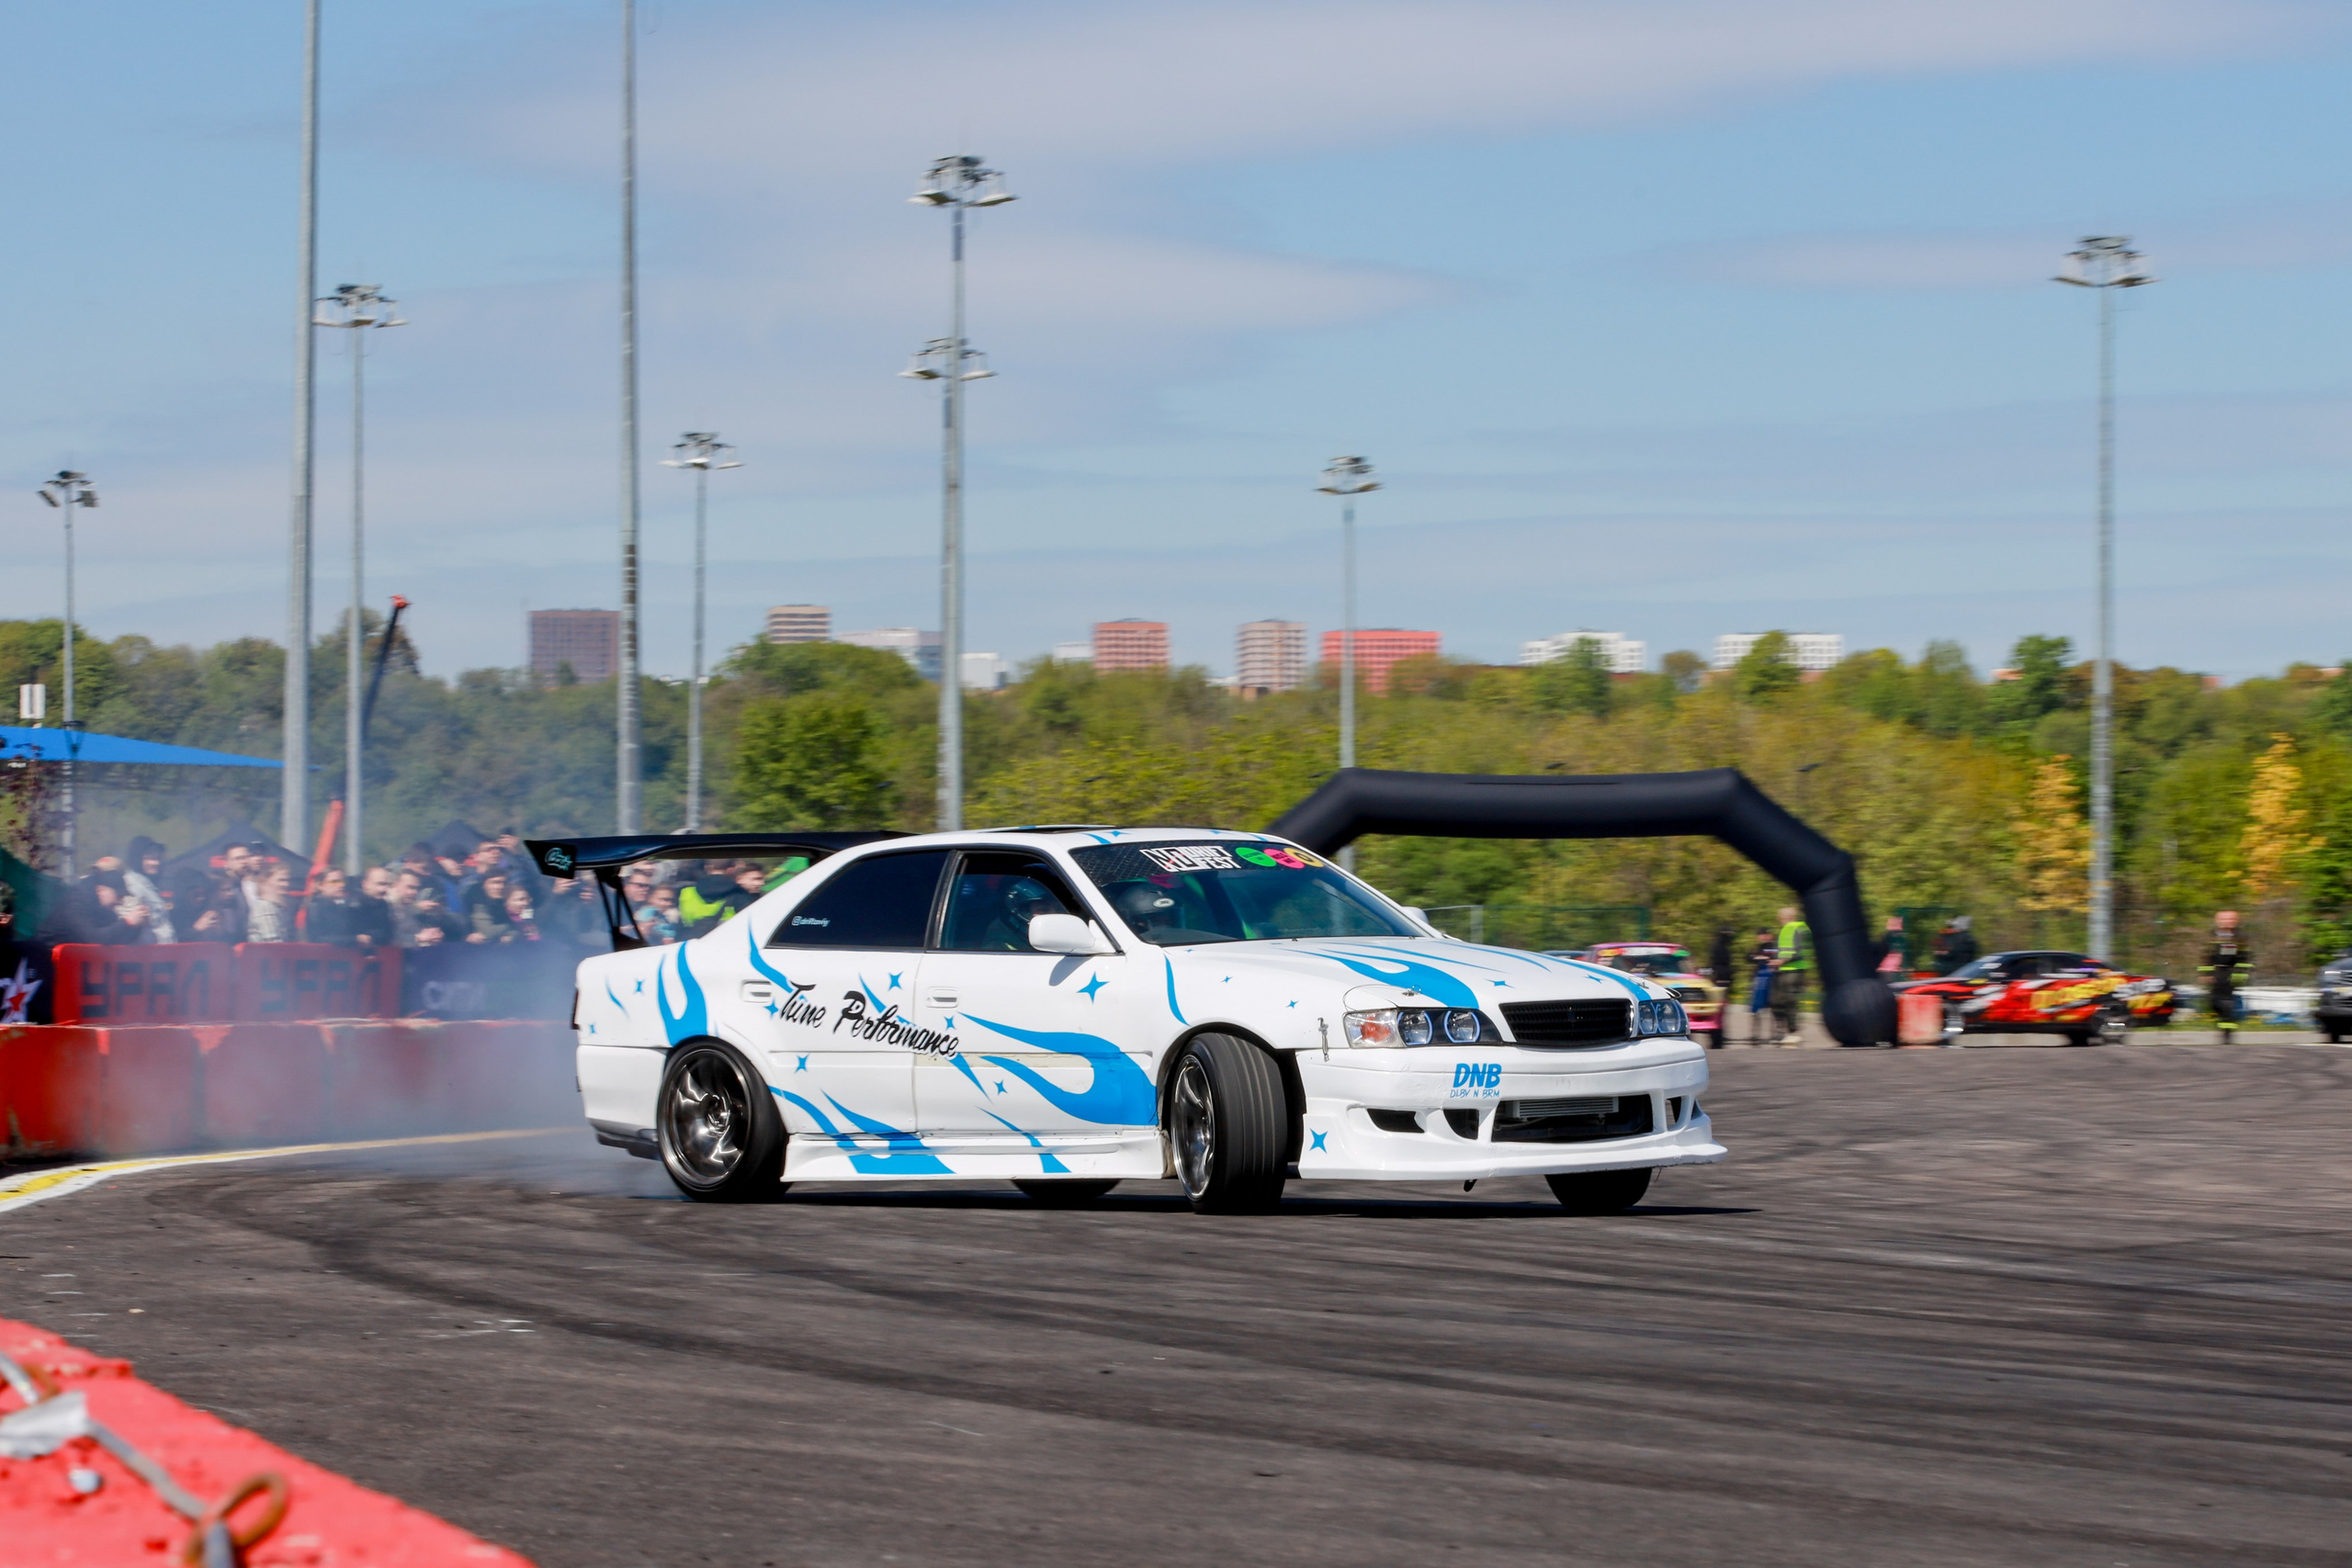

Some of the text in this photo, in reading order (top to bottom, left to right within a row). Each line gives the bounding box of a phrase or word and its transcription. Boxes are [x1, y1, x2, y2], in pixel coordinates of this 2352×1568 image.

[1180, 846, 1233, 857] DRIFT
[1194, 857, 1241, 869] FEST
[781, 980, 959, 1057] Tune Performance
[1453, 1063, 1502, 1089] DNB
